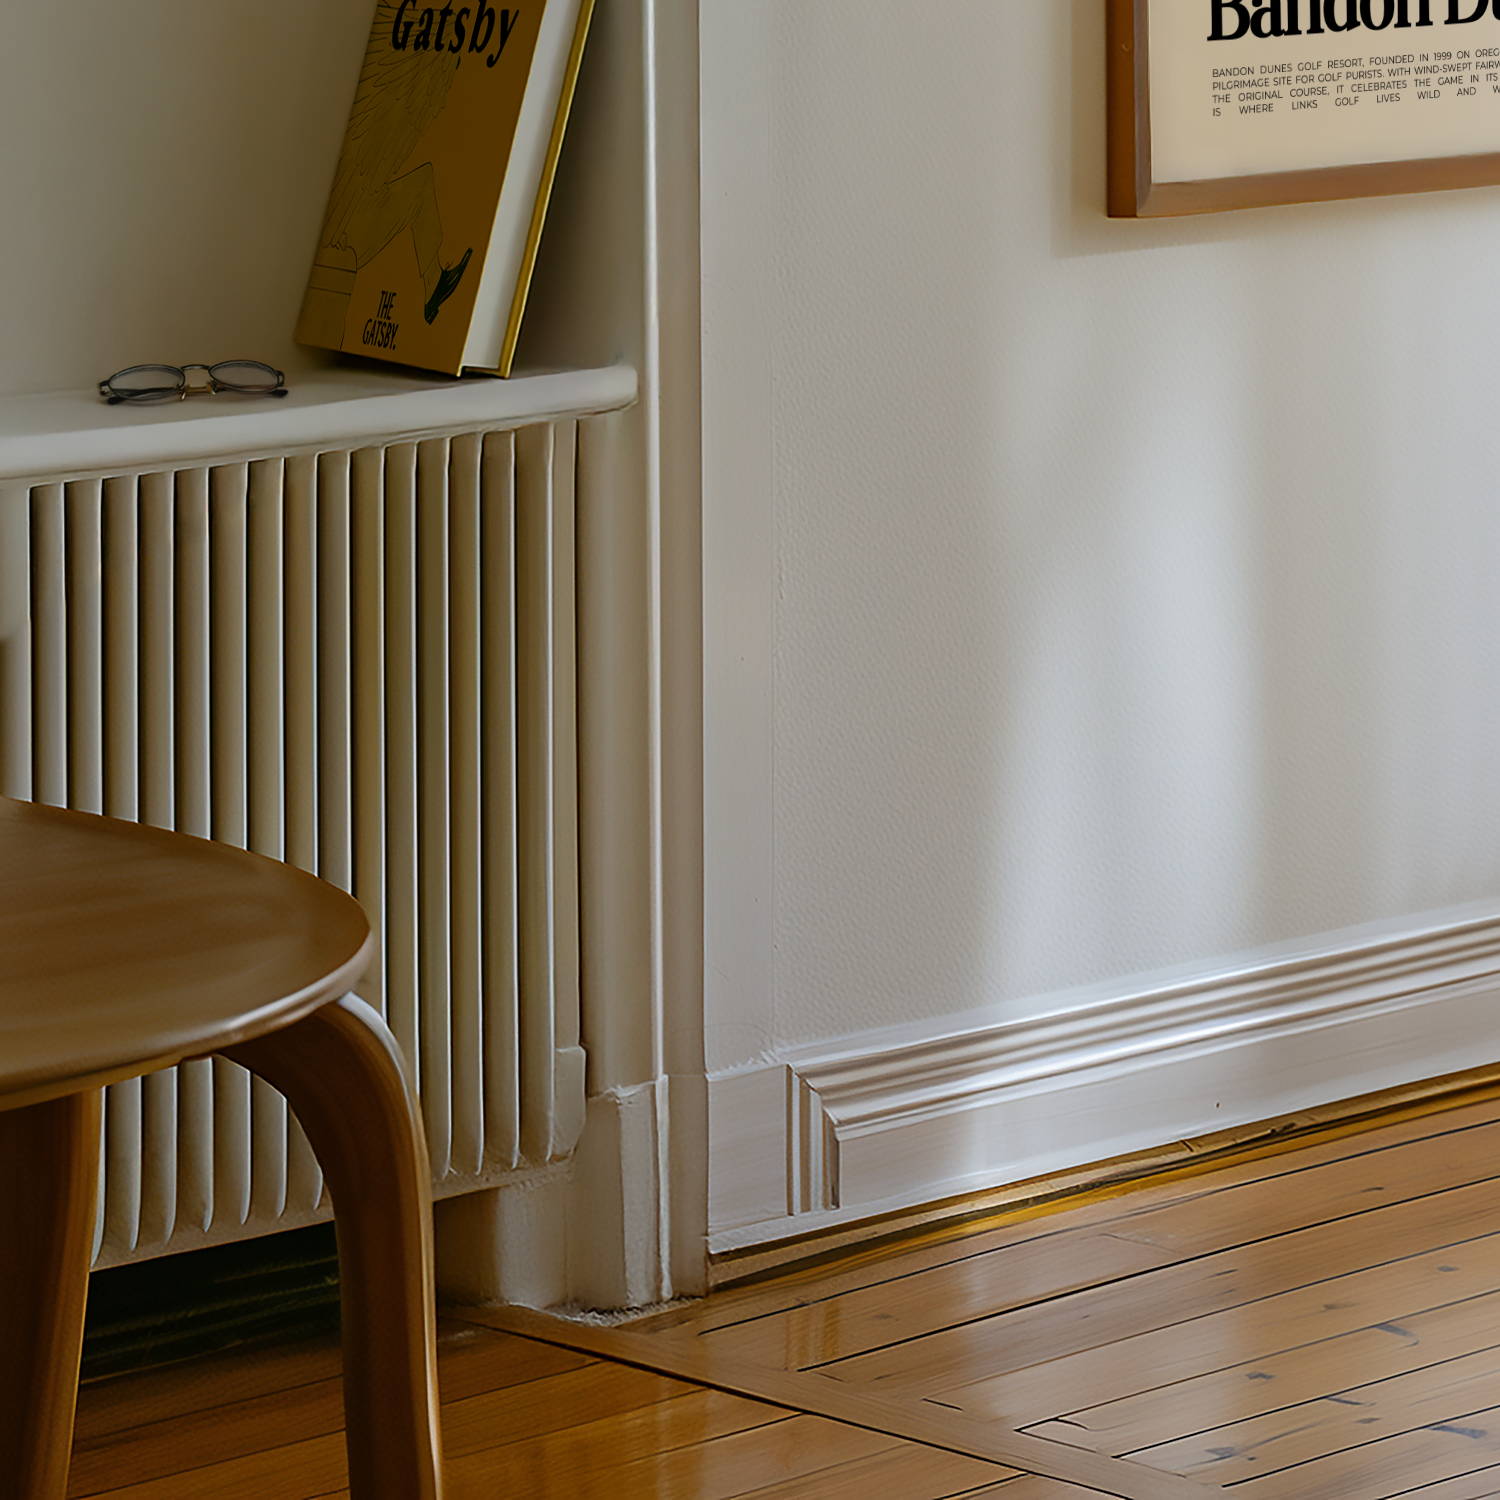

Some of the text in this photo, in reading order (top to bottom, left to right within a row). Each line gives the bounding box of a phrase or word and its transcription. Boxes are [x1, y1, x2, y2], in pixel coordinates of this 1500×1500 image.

[1212, 66, 1255, 78] BANDON
[1260, 63, 1293, 75] DUNES
[1297, 60, 1322, 72] GOLF
[1327, 57, 1365, 69] RESORT,
[1369, 54, 1415, 66] FOUNDED
[1419, 53, 1429, 62] IN
[1433, 51, 1452, 61] 1999
[1456, 50, 1470, 60] ON
[1212, 77, 1270, 91] PILGRIMAGE
[1273, 75, 1292, 87] SITE
[1295, 74, 1315, 84] FOR
[1317, 71, 1343, 83] GOLF
[1345, 68, 1385, 80] PURISTS.
[1387, 67, 1411, 77] WITH
[1413, 62, 1473, 75] WIND-SWEPT
[1212, 93, 1231, 104] THE
[1238, 90, 1283, 102] ORIGINAL
[1289, 86, 1330, 98] COURSE,
[1336, 84, 1344, 94] IT
[1350, 79, 1408, 93] CELEBRATES
[1413, 77, 1431, 88] THE
[1437, 75, 1464, 86] GAME
[1470, 74, 1479, 83] IN
[1486, 72, 1499, 82] ITS
[1212, 107, 1221, 117] IS
[1238, 102, 1274, 115] WHERE
[1291, 99, 1318, 111] LINKS
[1334, 96, 1359, 107] GOLF
[1376, 92, 1401, 104] LIVES
[1417, 89, 1441, 100] WILD
[1456, 86, 1477, 97] AND
[377, 290, 397, 320] THE
[362, 318, 399, 350] GATSBY.
